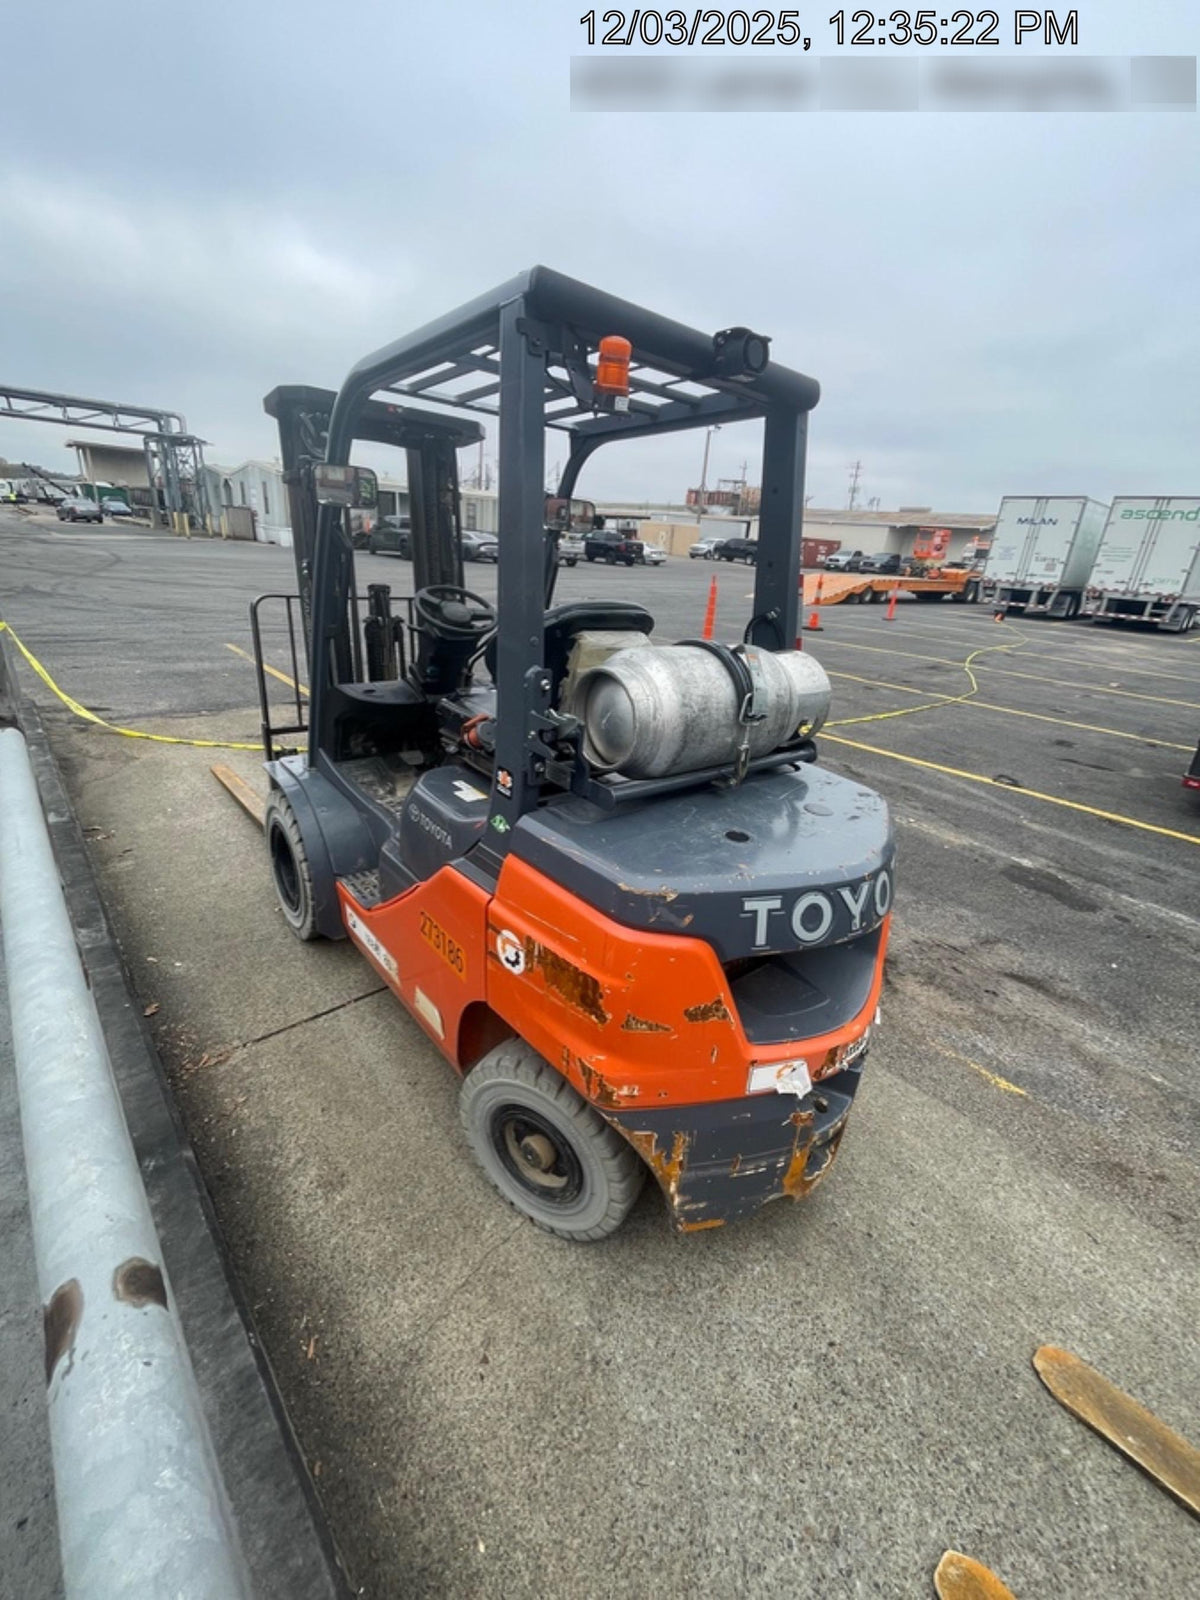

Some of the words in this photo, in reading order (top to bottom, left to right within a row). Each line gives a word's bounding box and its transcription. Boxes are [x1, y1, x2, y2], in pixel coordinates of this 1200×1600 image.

[1120, 507, 1200, 521] ascend
[419, 811, 453, 850] TOYOTA
[742, 856, 895, 948] TOYO
